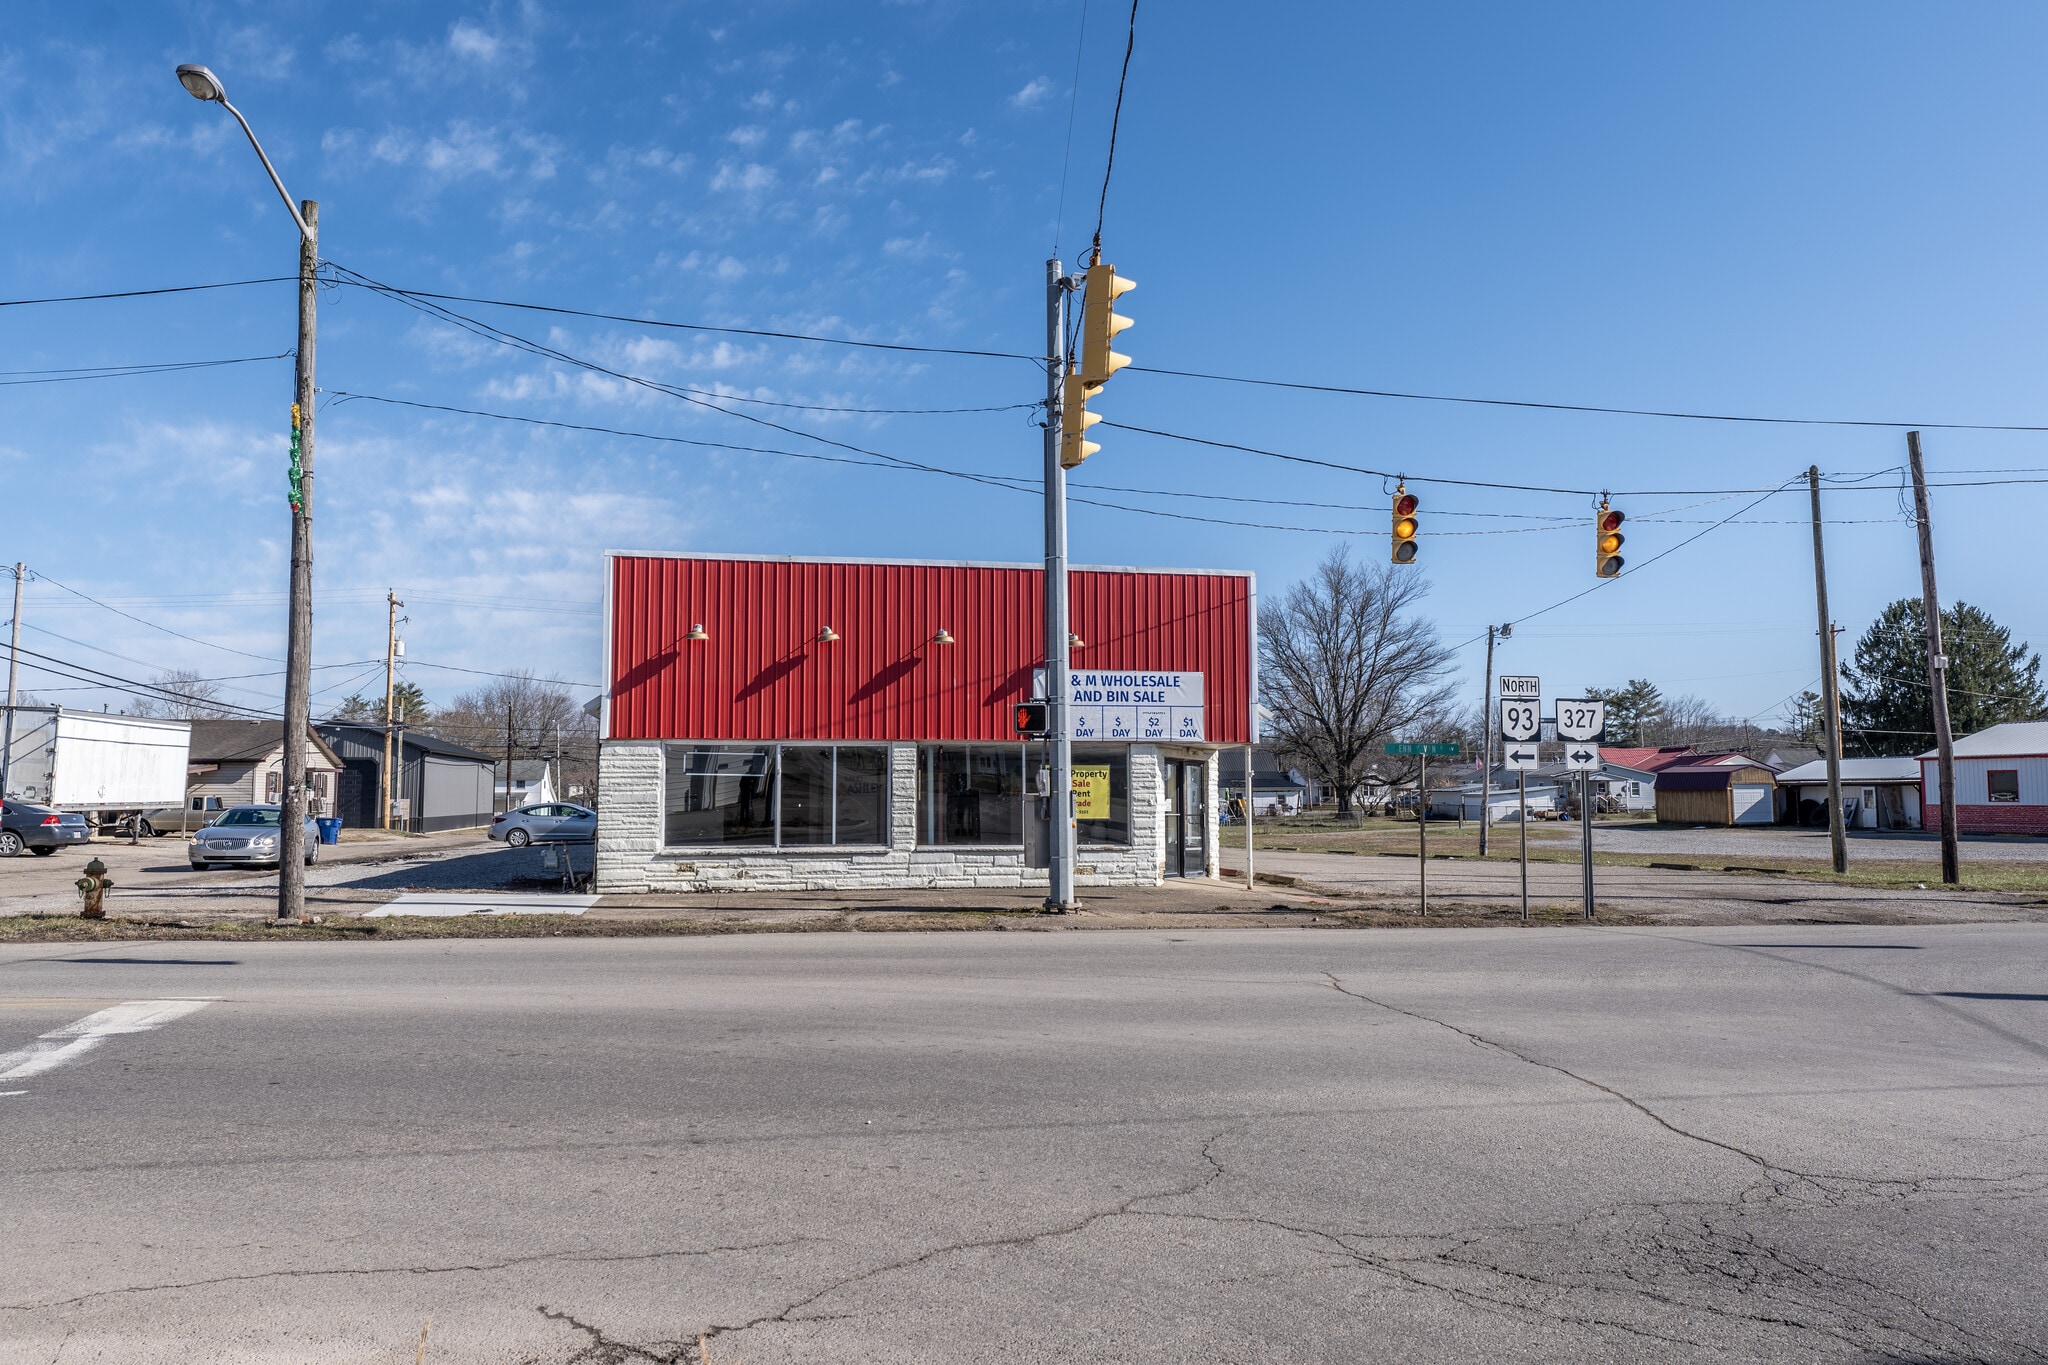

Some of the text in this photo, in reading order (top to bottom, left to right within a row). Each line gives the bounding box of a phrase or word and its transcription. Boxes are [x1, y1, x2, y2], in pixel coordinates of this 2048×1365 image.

[1071, 674, 1180, 688] & M WHOLESALE
[1502, 679, 1537, 693] NORTH
[1074, 690, 1166, 703] AND BIN SALE
[1079, 716, 1085, 727] $
[1115, 716, 1121, 727] $
[1148, 717, 1159, 728] $2
[1183, 717, 1193, 728] $1
[1508, 707, 1534, 731] 93
[1564, 709, 1597, 729] 327
[1076, 729, 1094, 737] DAY
[1112, 729, 1130, 737] DAY
[1145, 729, 1163, 738] DAY
[1180, 729, 1197, 738] DAY
[1071, 770, 1107, 779] Property
[1072, 779, 1091, 788] Sale
[1075, 799, 1091, 807] ade
